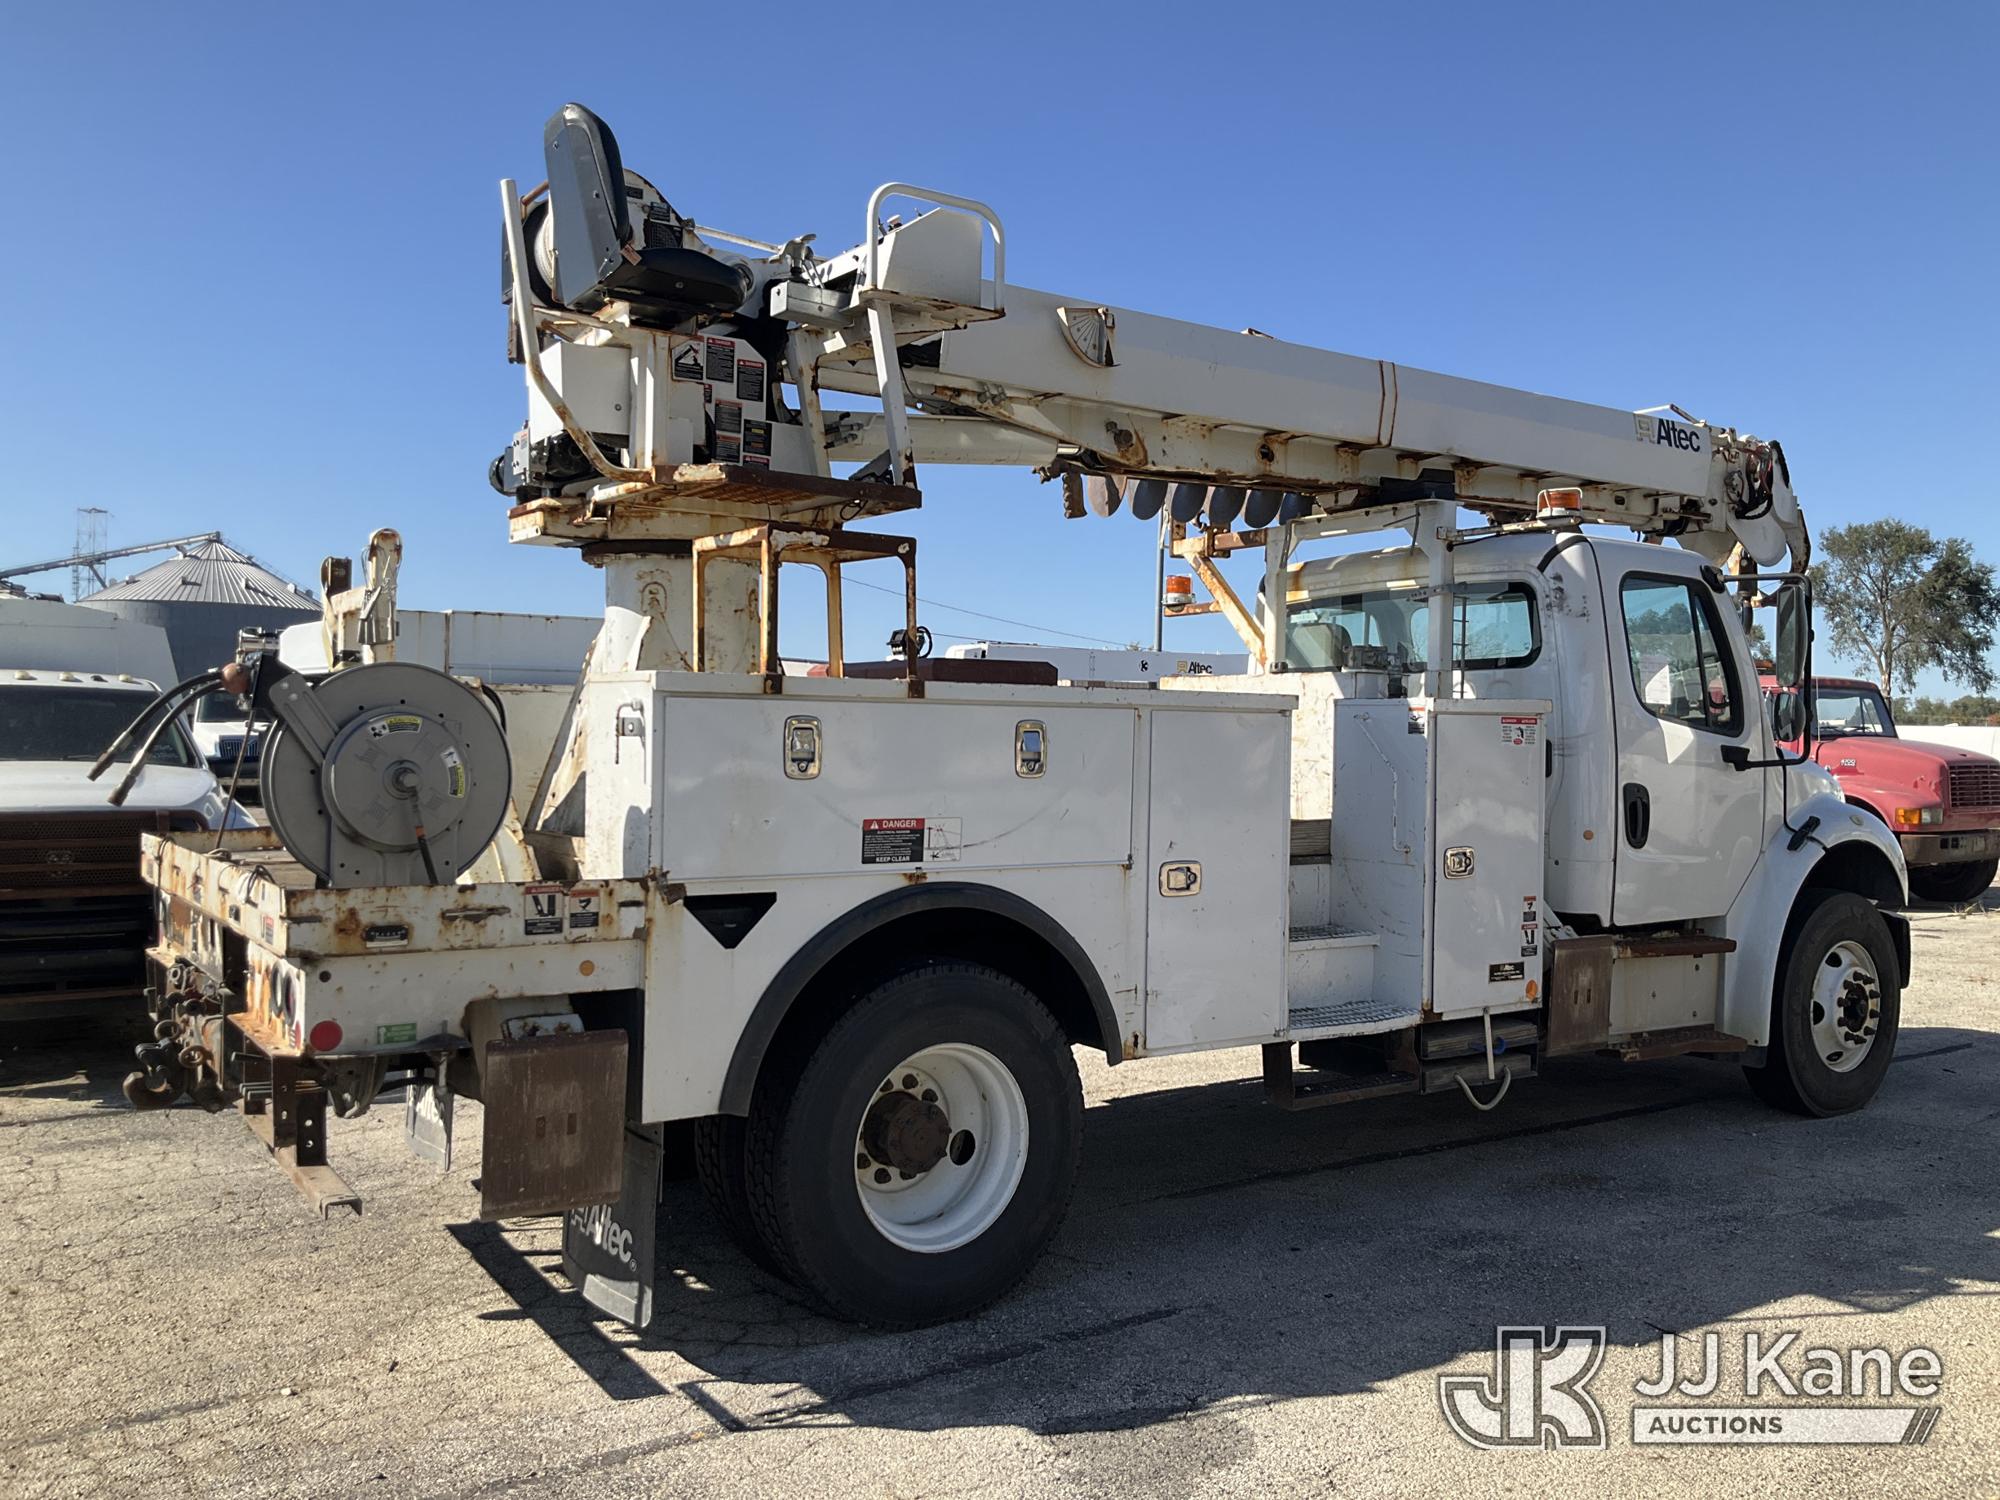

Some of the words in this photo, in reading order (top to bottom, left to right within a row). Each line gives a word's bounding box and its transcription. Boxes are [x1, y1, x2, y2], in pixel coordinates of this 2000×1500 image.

[1657, 418, 1701, 453] Altec
[1188, 661, 1213, 674] Altec
[882, 819, 917, 829] DANGER
[585, 1203, 633, 1263] Altec
